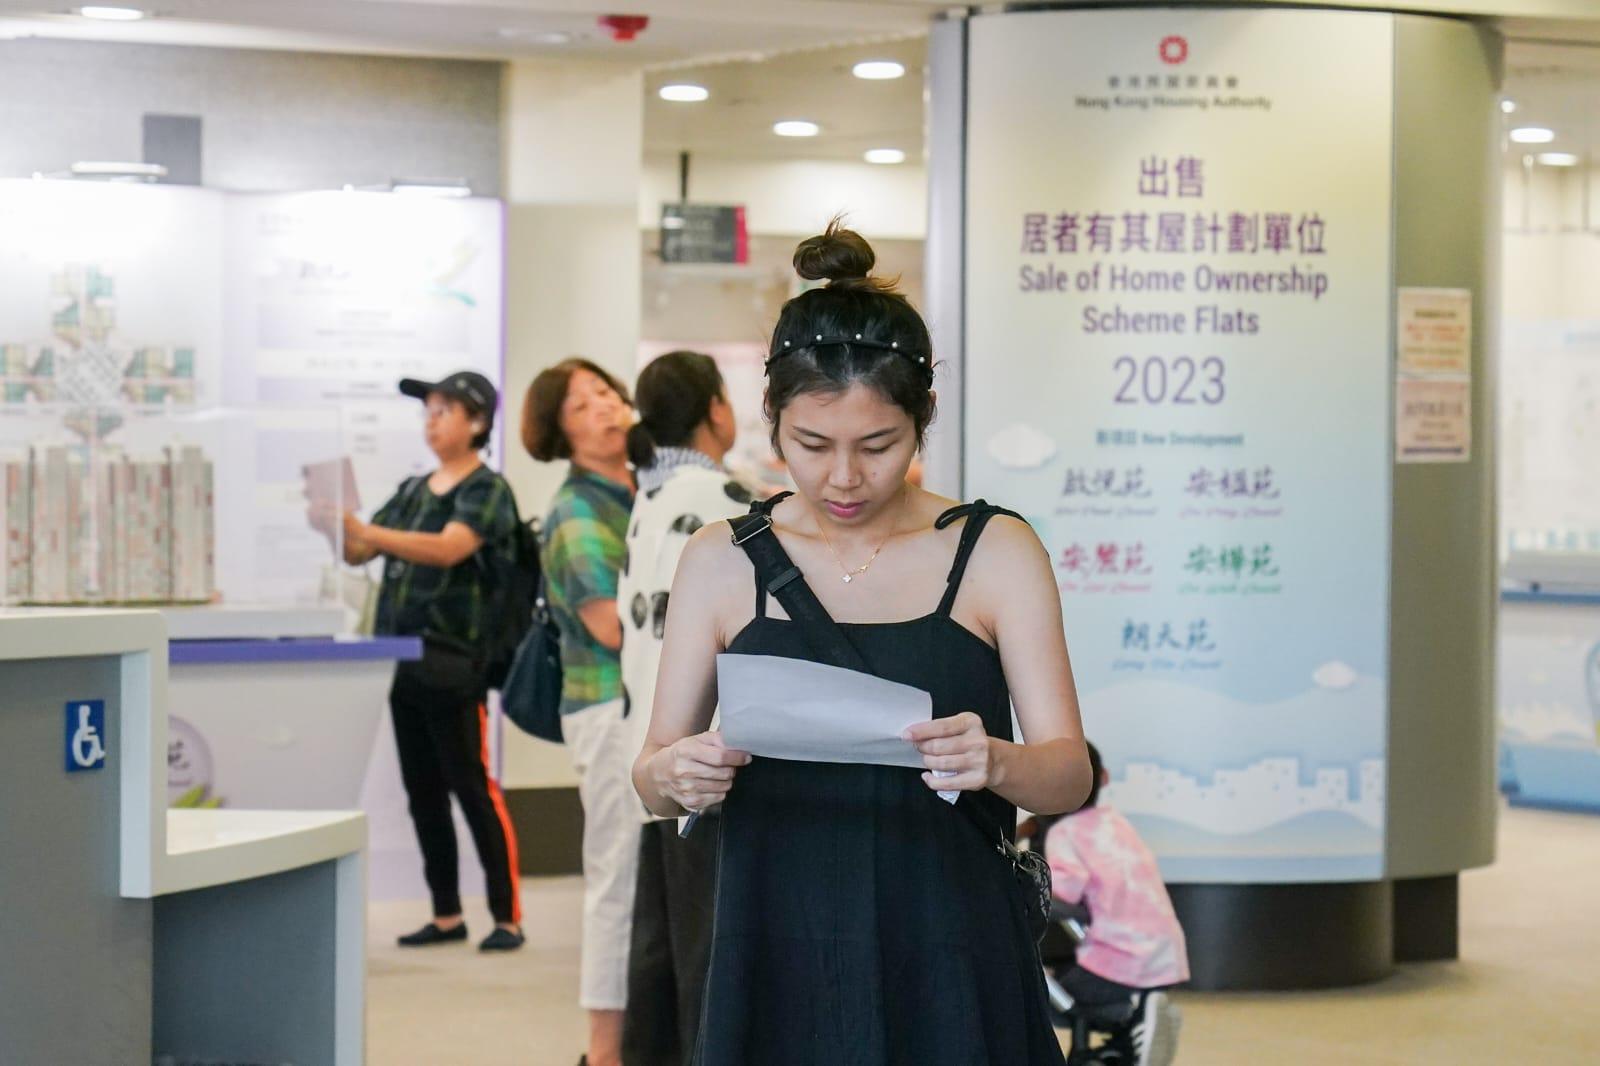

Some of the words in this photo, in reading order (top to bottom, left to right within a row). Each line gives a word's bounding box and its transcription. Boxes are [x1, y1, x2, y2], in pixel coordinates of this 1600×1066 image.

[1075, 96, 1110, 110] Hong
[1138, 155, 1204, 198] 出售
[1021, 211, 1327, 254] 居者有其屋計劃單位
[1019, 263, 1068, 292] Sale
[1076, 263, 1101, 292] of
[1109, 265, 1186, 292] Home
[1194, 264, 1329, 300] Ownership
[1082, 304, 1186, 334] Scheme
[1195, 305, 1260, 334] Flats
[1112, 355, 1227, 405] 2023
